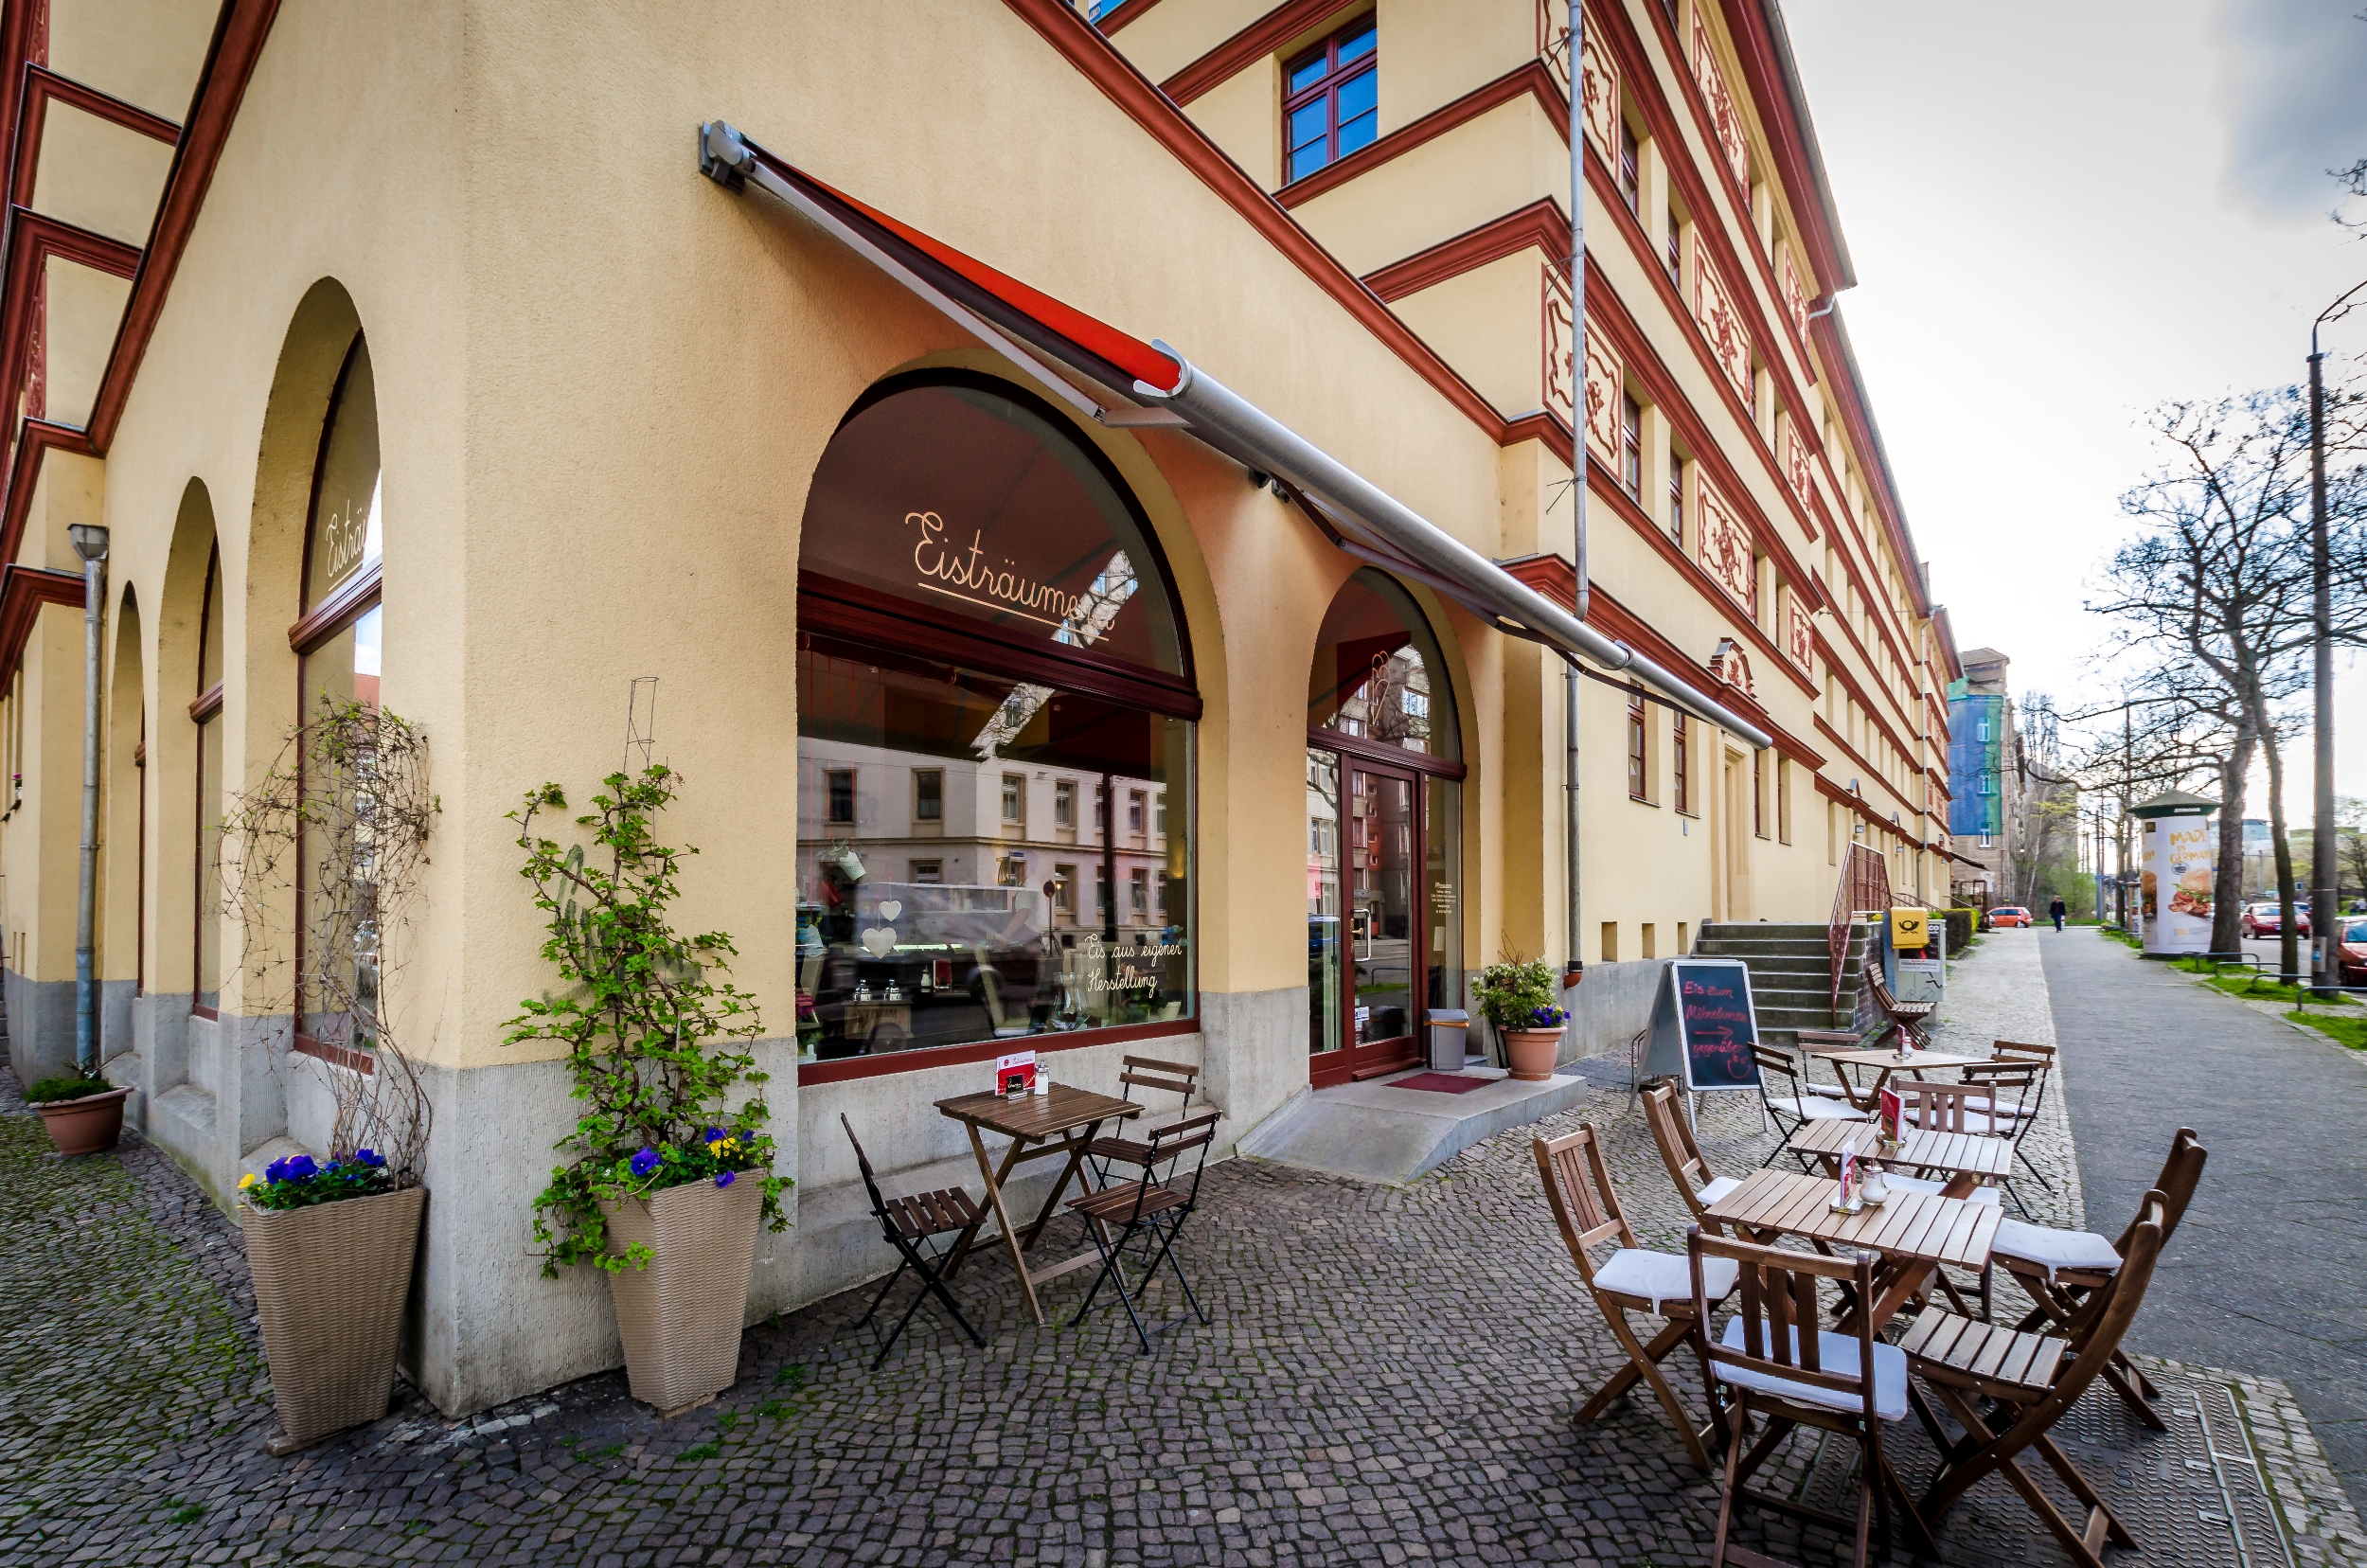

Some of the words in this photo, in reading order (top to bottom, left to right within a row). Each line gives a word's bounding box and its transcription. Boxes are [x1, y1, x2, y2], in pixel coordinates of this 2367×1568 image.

[1085, 934, 1106, 958] Eis
[1112, 946, 1135, 959] aus
[1141, 944, 1183, 967] eigener
[1087, 965, 1158, 999] Herstellung
[1683, 980, 1705, 995] Eis
